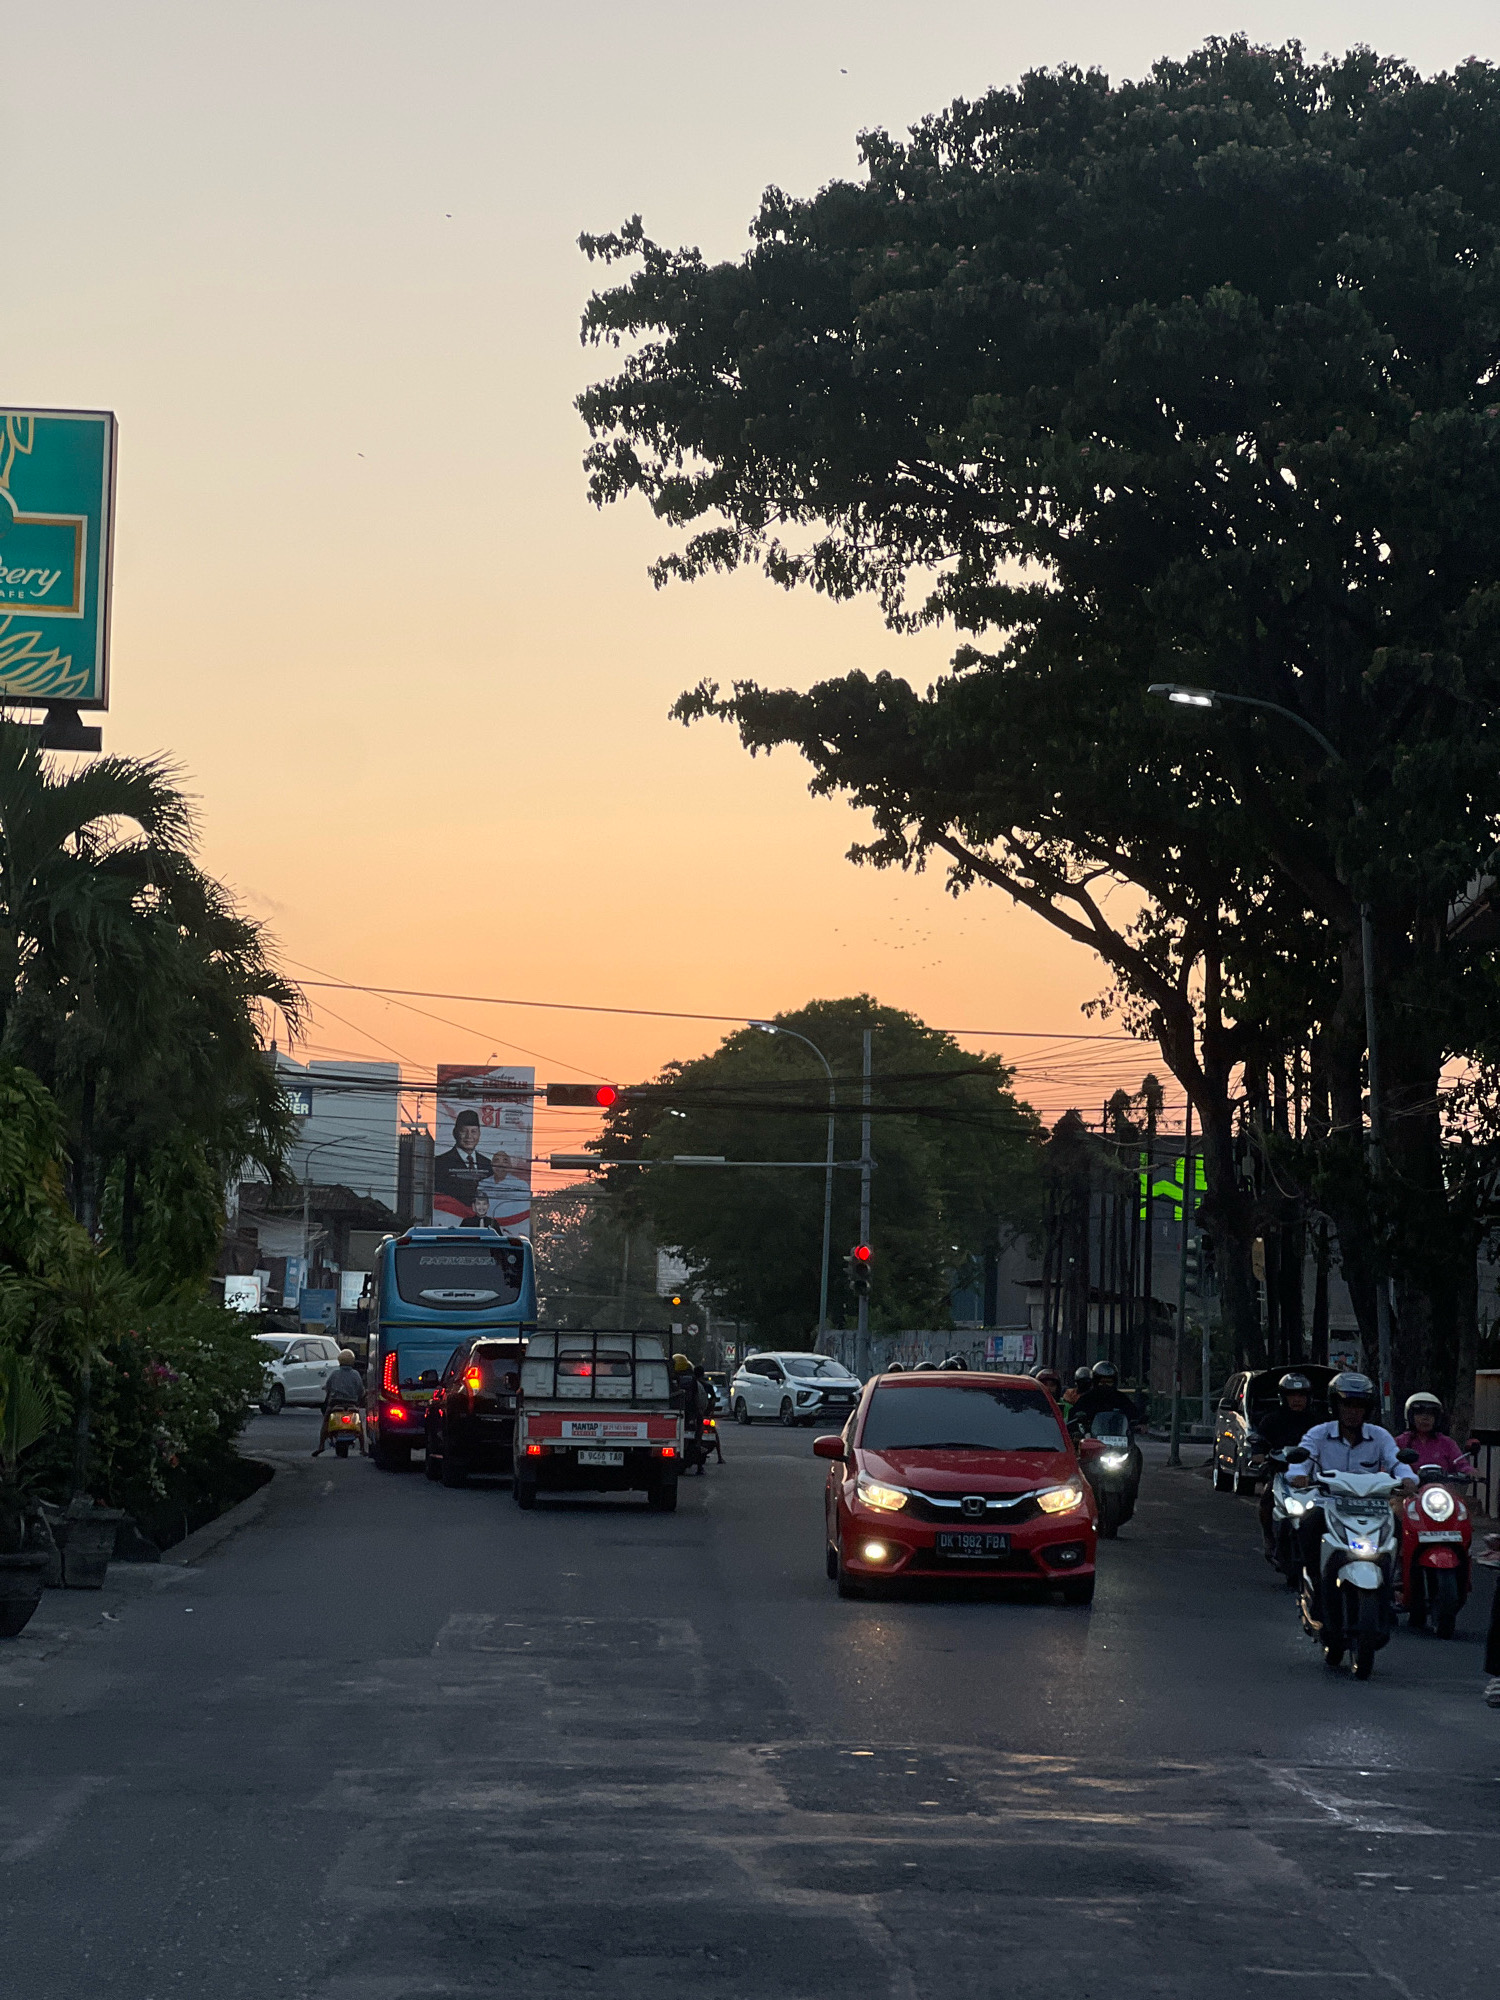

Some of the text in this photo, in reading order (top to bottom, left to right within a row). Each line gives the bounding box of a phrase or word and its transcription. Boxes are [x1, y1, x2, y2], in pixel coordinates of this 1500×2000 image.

[482, 1105, 503, 1128] 81
[571, 1422, 598, 1431] MANTAP
[940, 1534, 1006, 1549] DK 1982 FBA
